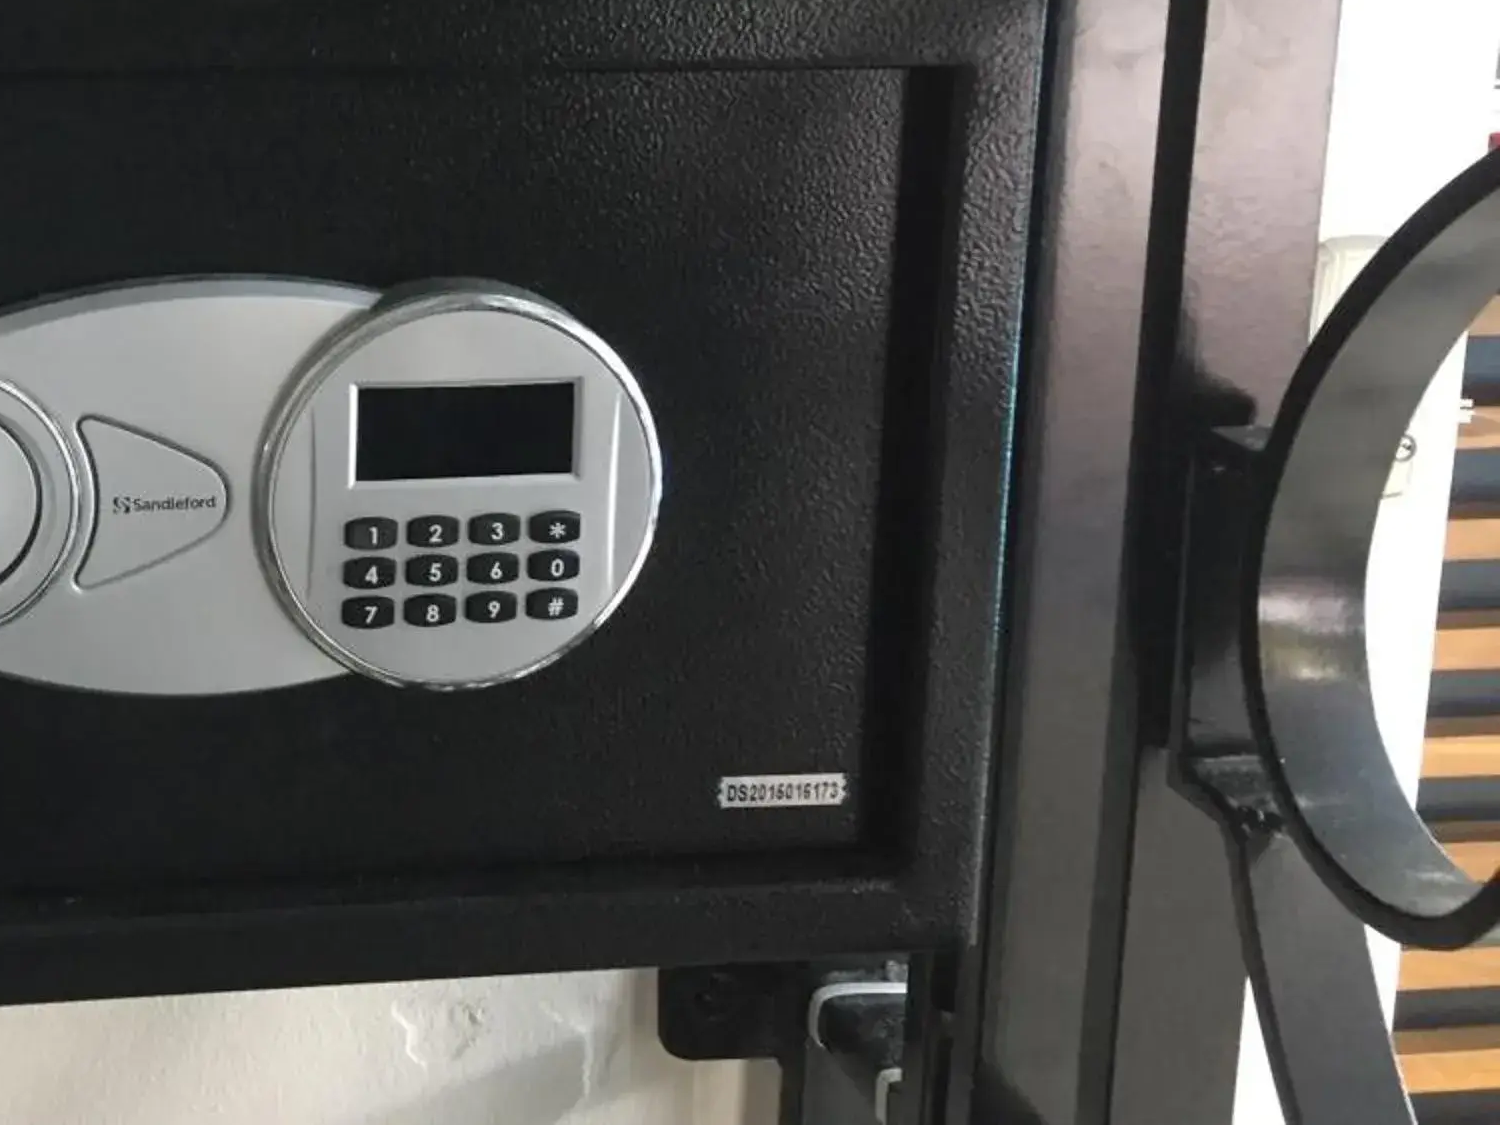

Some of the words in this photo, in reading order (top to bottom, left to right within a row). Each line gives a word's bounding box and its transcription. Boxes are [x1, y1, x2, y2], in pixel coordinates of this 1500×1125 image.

[133, 495, 216, 512] Sandleford
[369, 526, 378, 545] 1
[429, 524, 443, 543] 2
[491, 522, 503, 541] 3
[365, 565, 378, 584] 4
[430, 563, 441, 582] 5
[490, 561, 502, 580] 6
[551, 559, 564, 577] 0
[365, 606, 378, 624] 7
[426, 604, 440, 623] 8
[488, 601, 500, 618] 9
